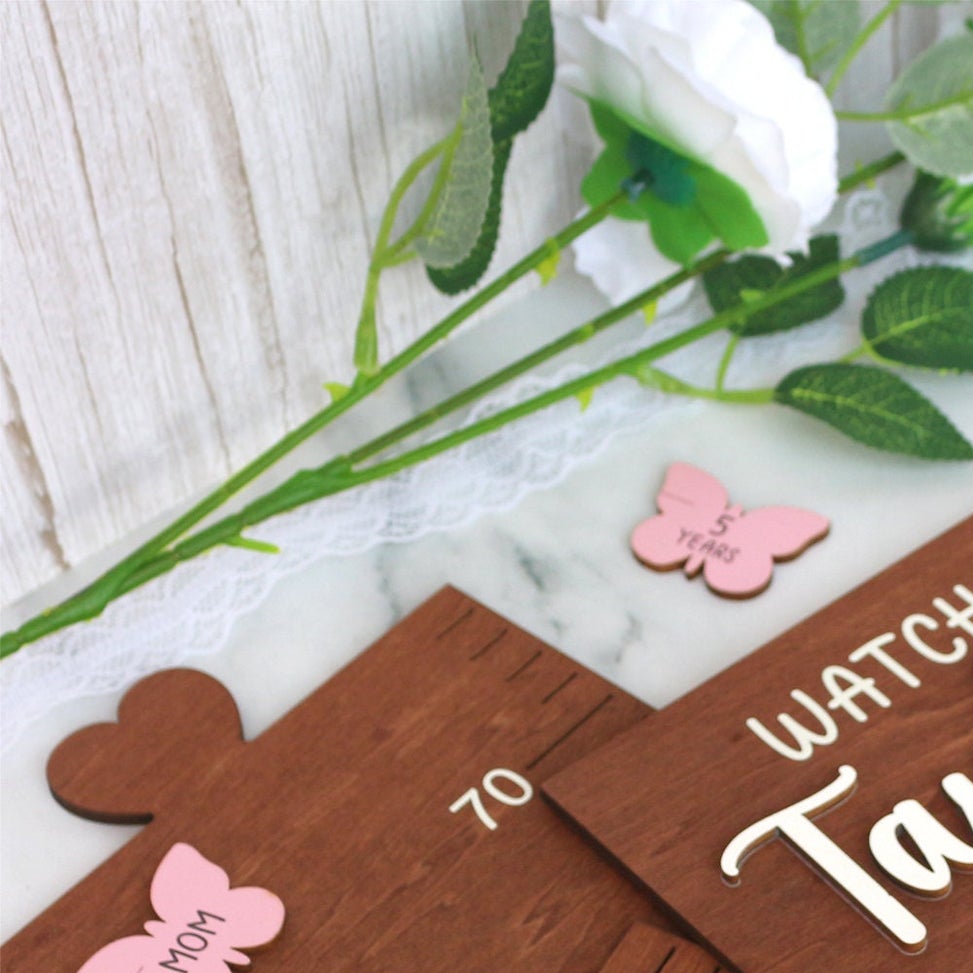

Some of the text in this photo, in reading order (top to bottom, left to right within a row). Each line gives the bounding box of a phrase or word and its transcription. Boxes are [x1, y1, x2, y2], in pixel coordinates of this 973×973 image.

[708, 513, 735, 537] 5
[677, 526, 741, 564] YEARS
[448, 767, 534, 831] 70
